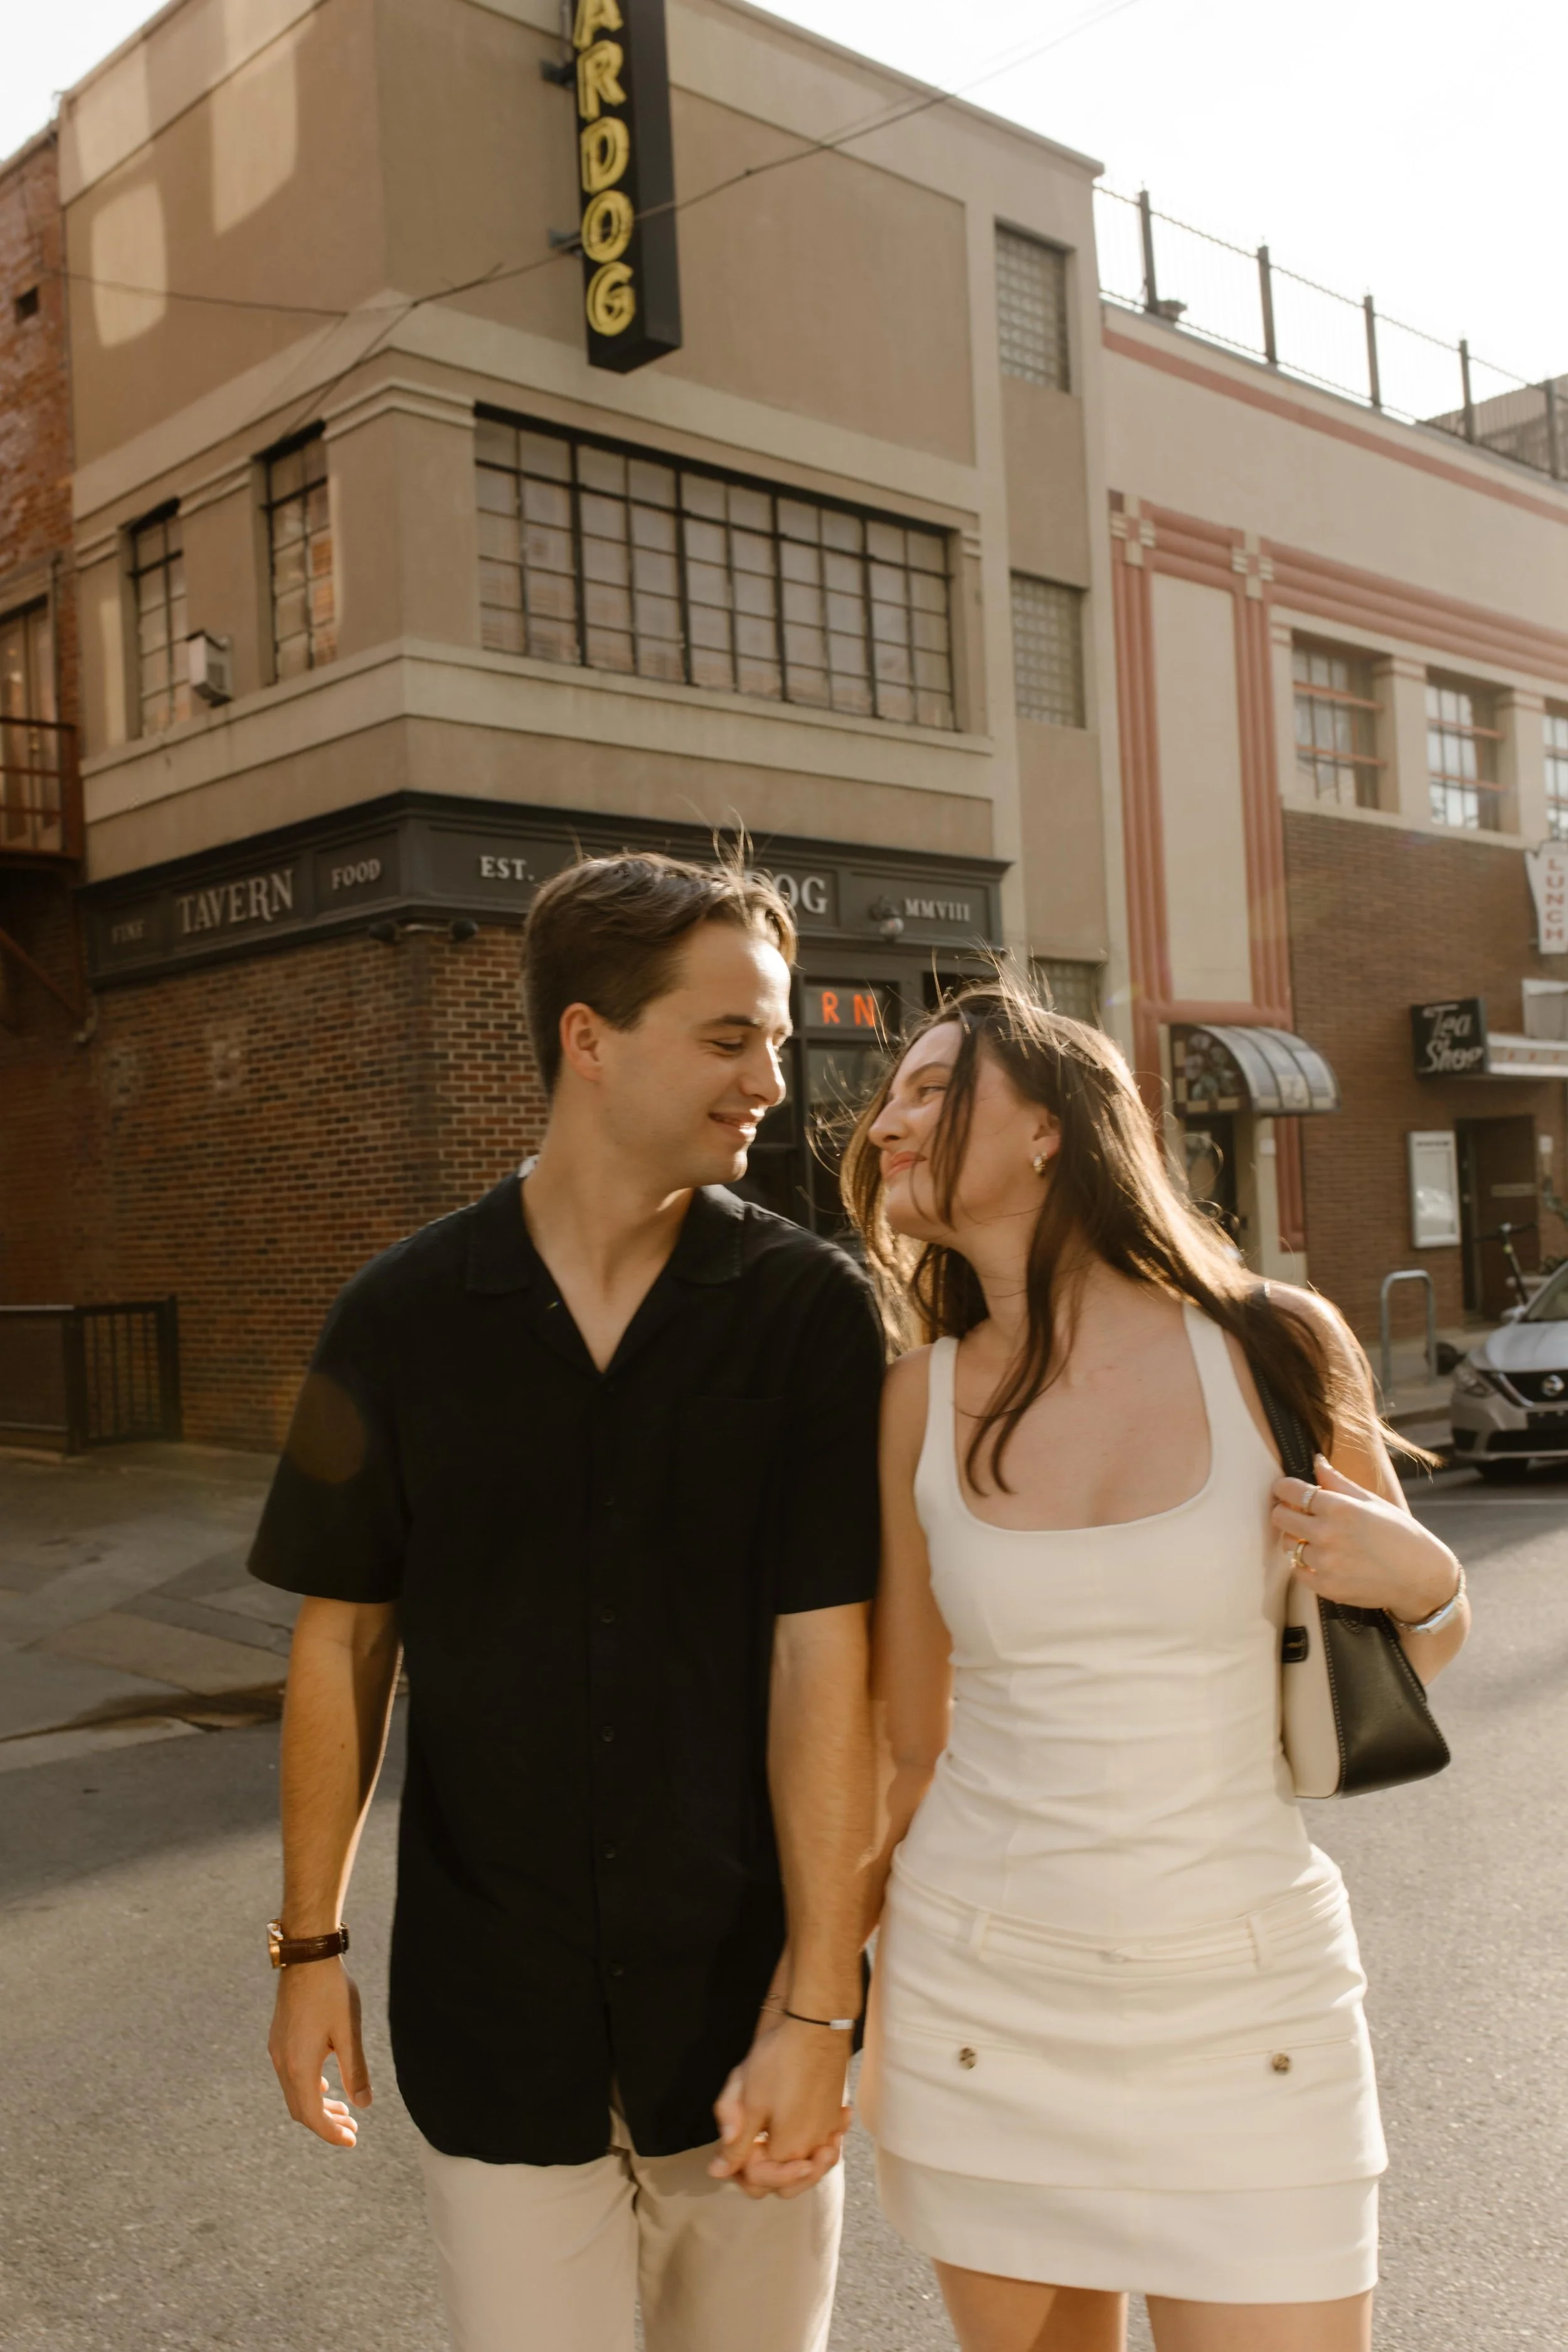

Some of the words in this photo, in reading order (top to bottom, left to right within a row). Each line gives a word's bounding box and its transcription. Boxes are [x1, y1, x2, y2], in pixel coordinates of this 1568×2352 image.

[177, 869, 294, 933] TAVERN
[332, 858, 381, 891] FOOD
[479, 855, 535, 882] EST.
[904, 896, 971, 922] MMVIII
[1545, 857, 1565, 940] LUNCH
